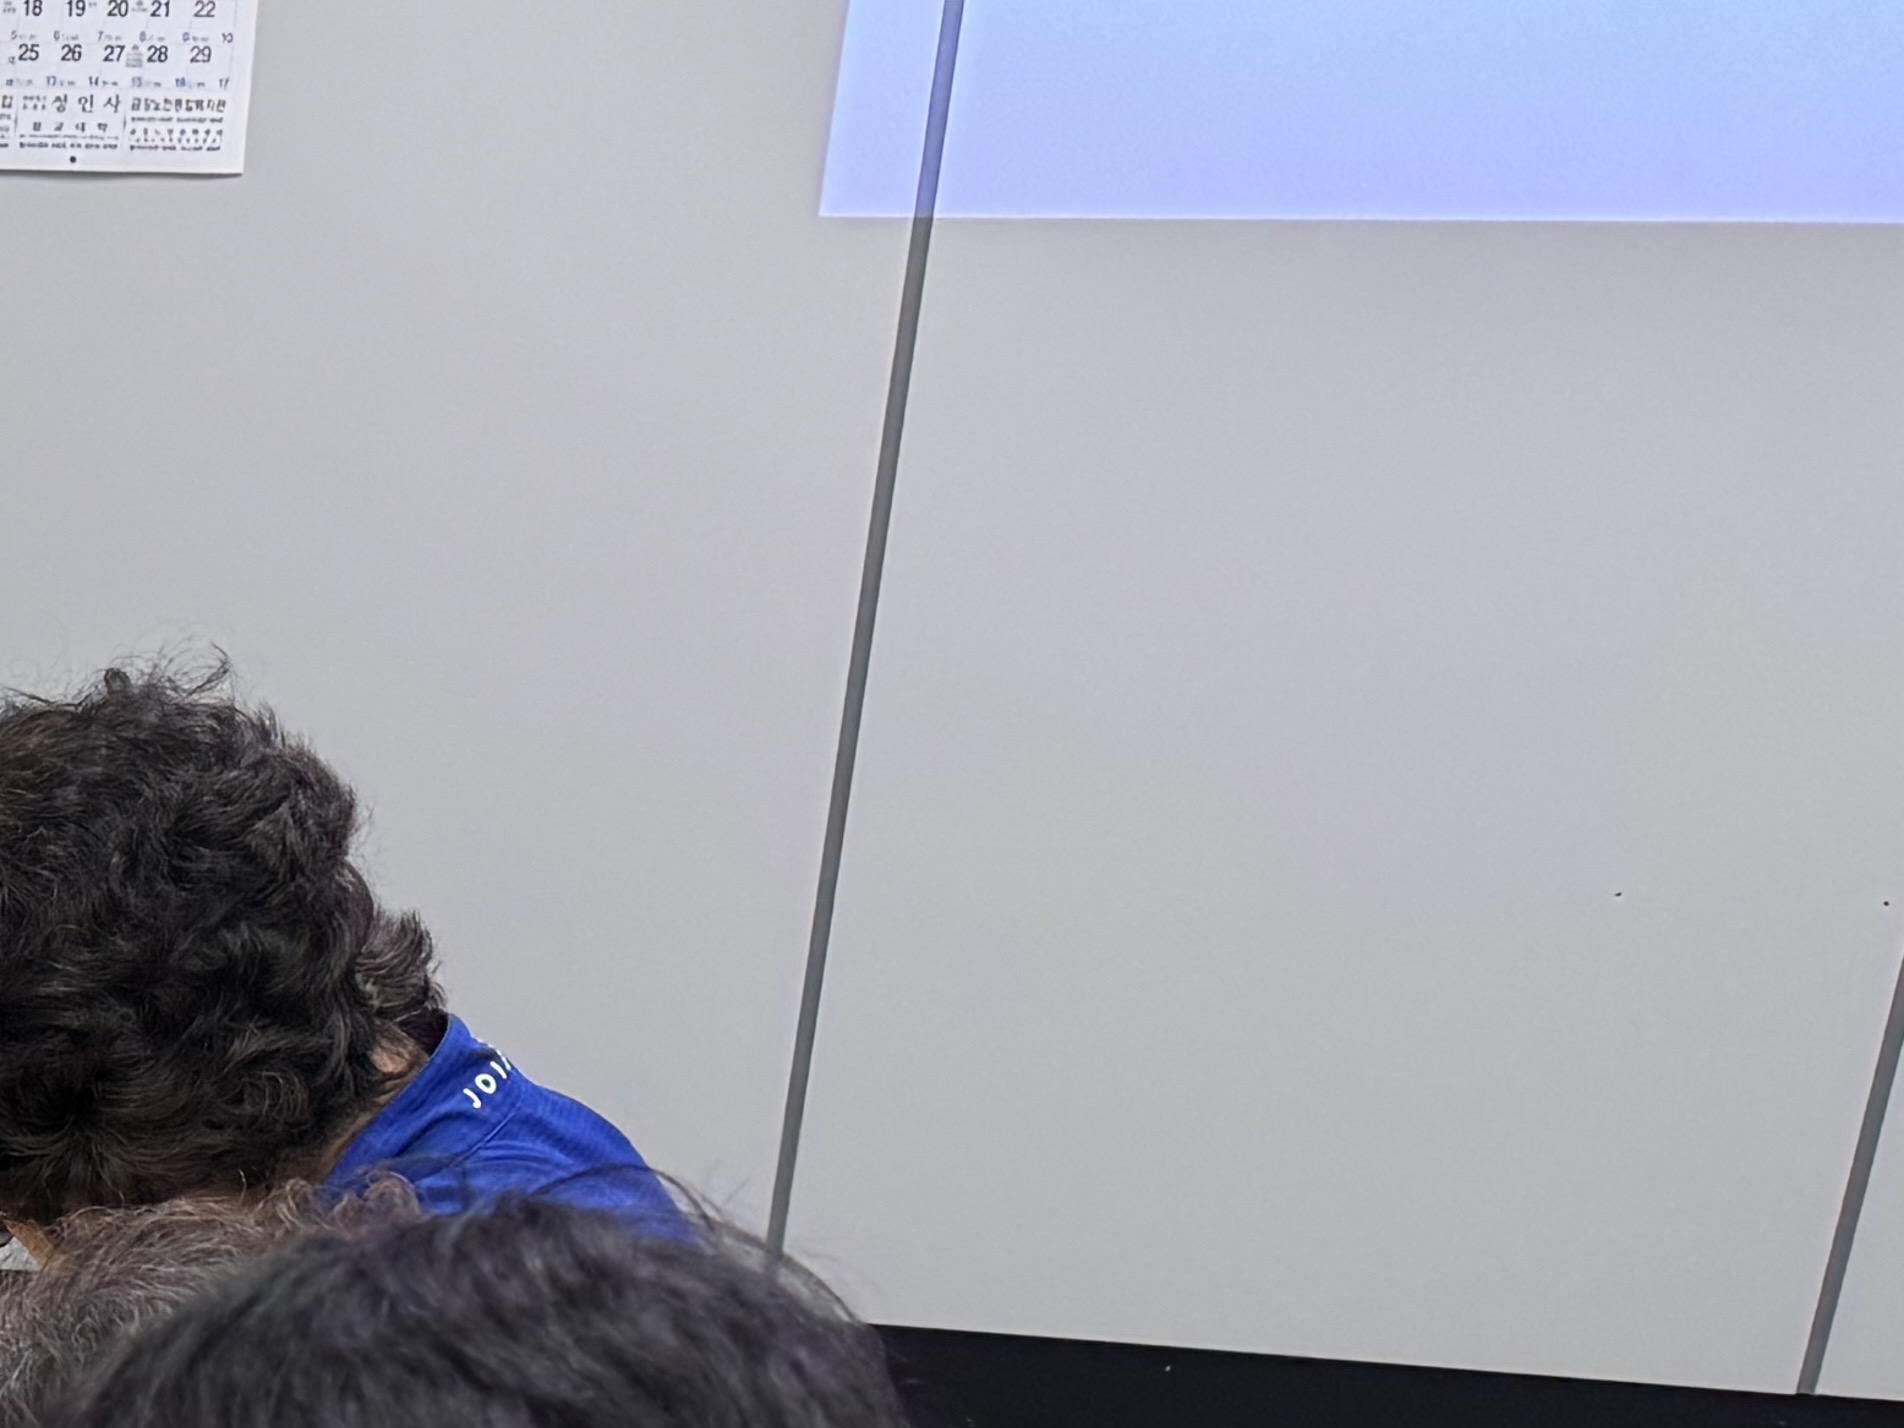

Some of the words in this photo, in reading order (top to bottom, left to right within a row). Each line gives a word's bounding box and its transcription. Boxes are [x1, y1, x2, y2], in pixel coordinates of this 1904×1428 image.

[23, 0, 43, 17] 18
[66, 0, 86, 17] 19
[106, 0, 129, 18] 20
[150, 0, 170, 18] 21
[193, 0, 216, 18] 22
[18, 43, 40, 62] 25
[60, 44, 82, 62] 26
[102, 44, 126, 63] 27
[146, 45, 169, 63] 28
[189, 46, 212, 64] 29
